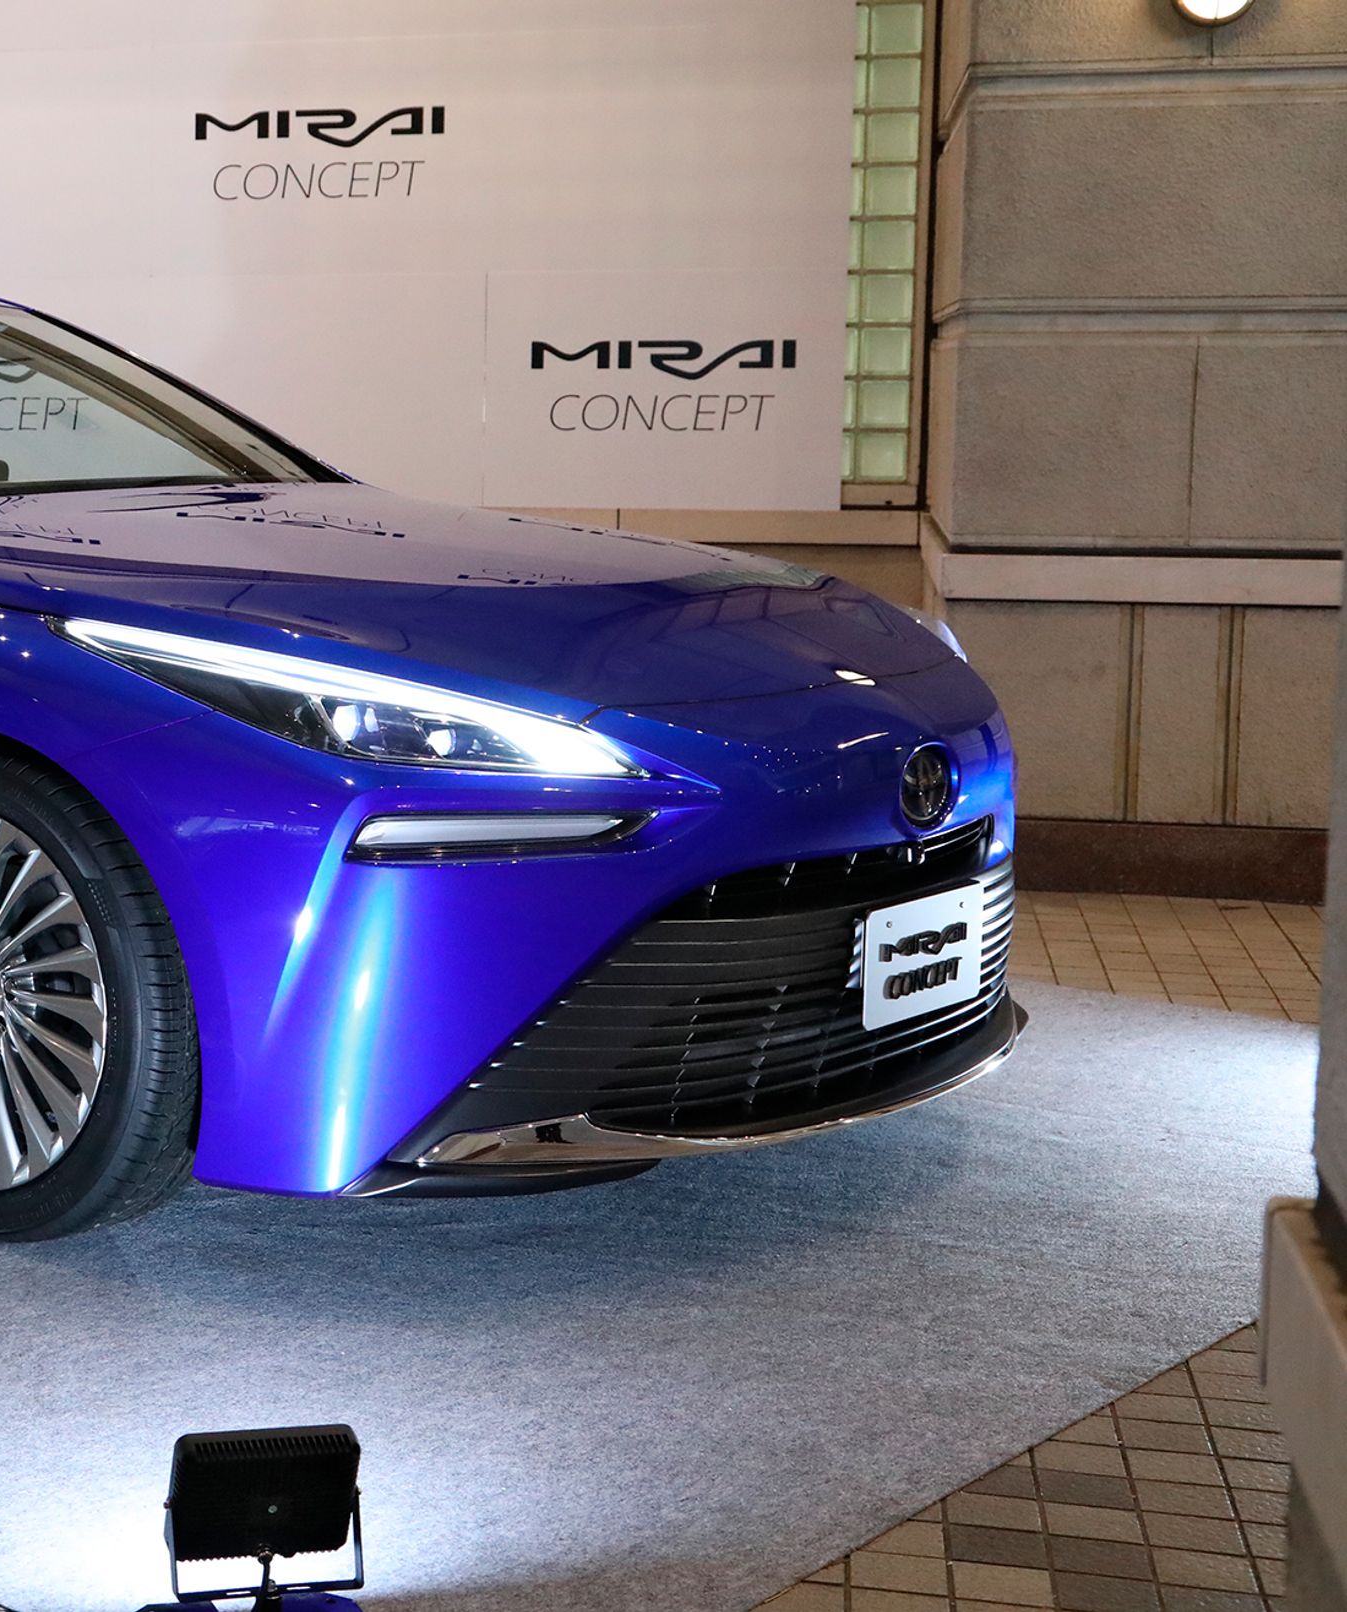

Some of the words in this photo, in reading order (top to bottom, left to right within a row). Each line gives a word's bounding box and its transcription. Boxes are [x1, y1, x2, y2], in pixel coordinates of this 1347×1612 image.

[195, 105, 445, 147] MIRAI
[213, 160, 425, 200] CONCEPT
[530, 339, 796, 380] MIRAI
[550, 394, 775, 431] CONCEPT
[878, 921, 968, 962] MIRAI
